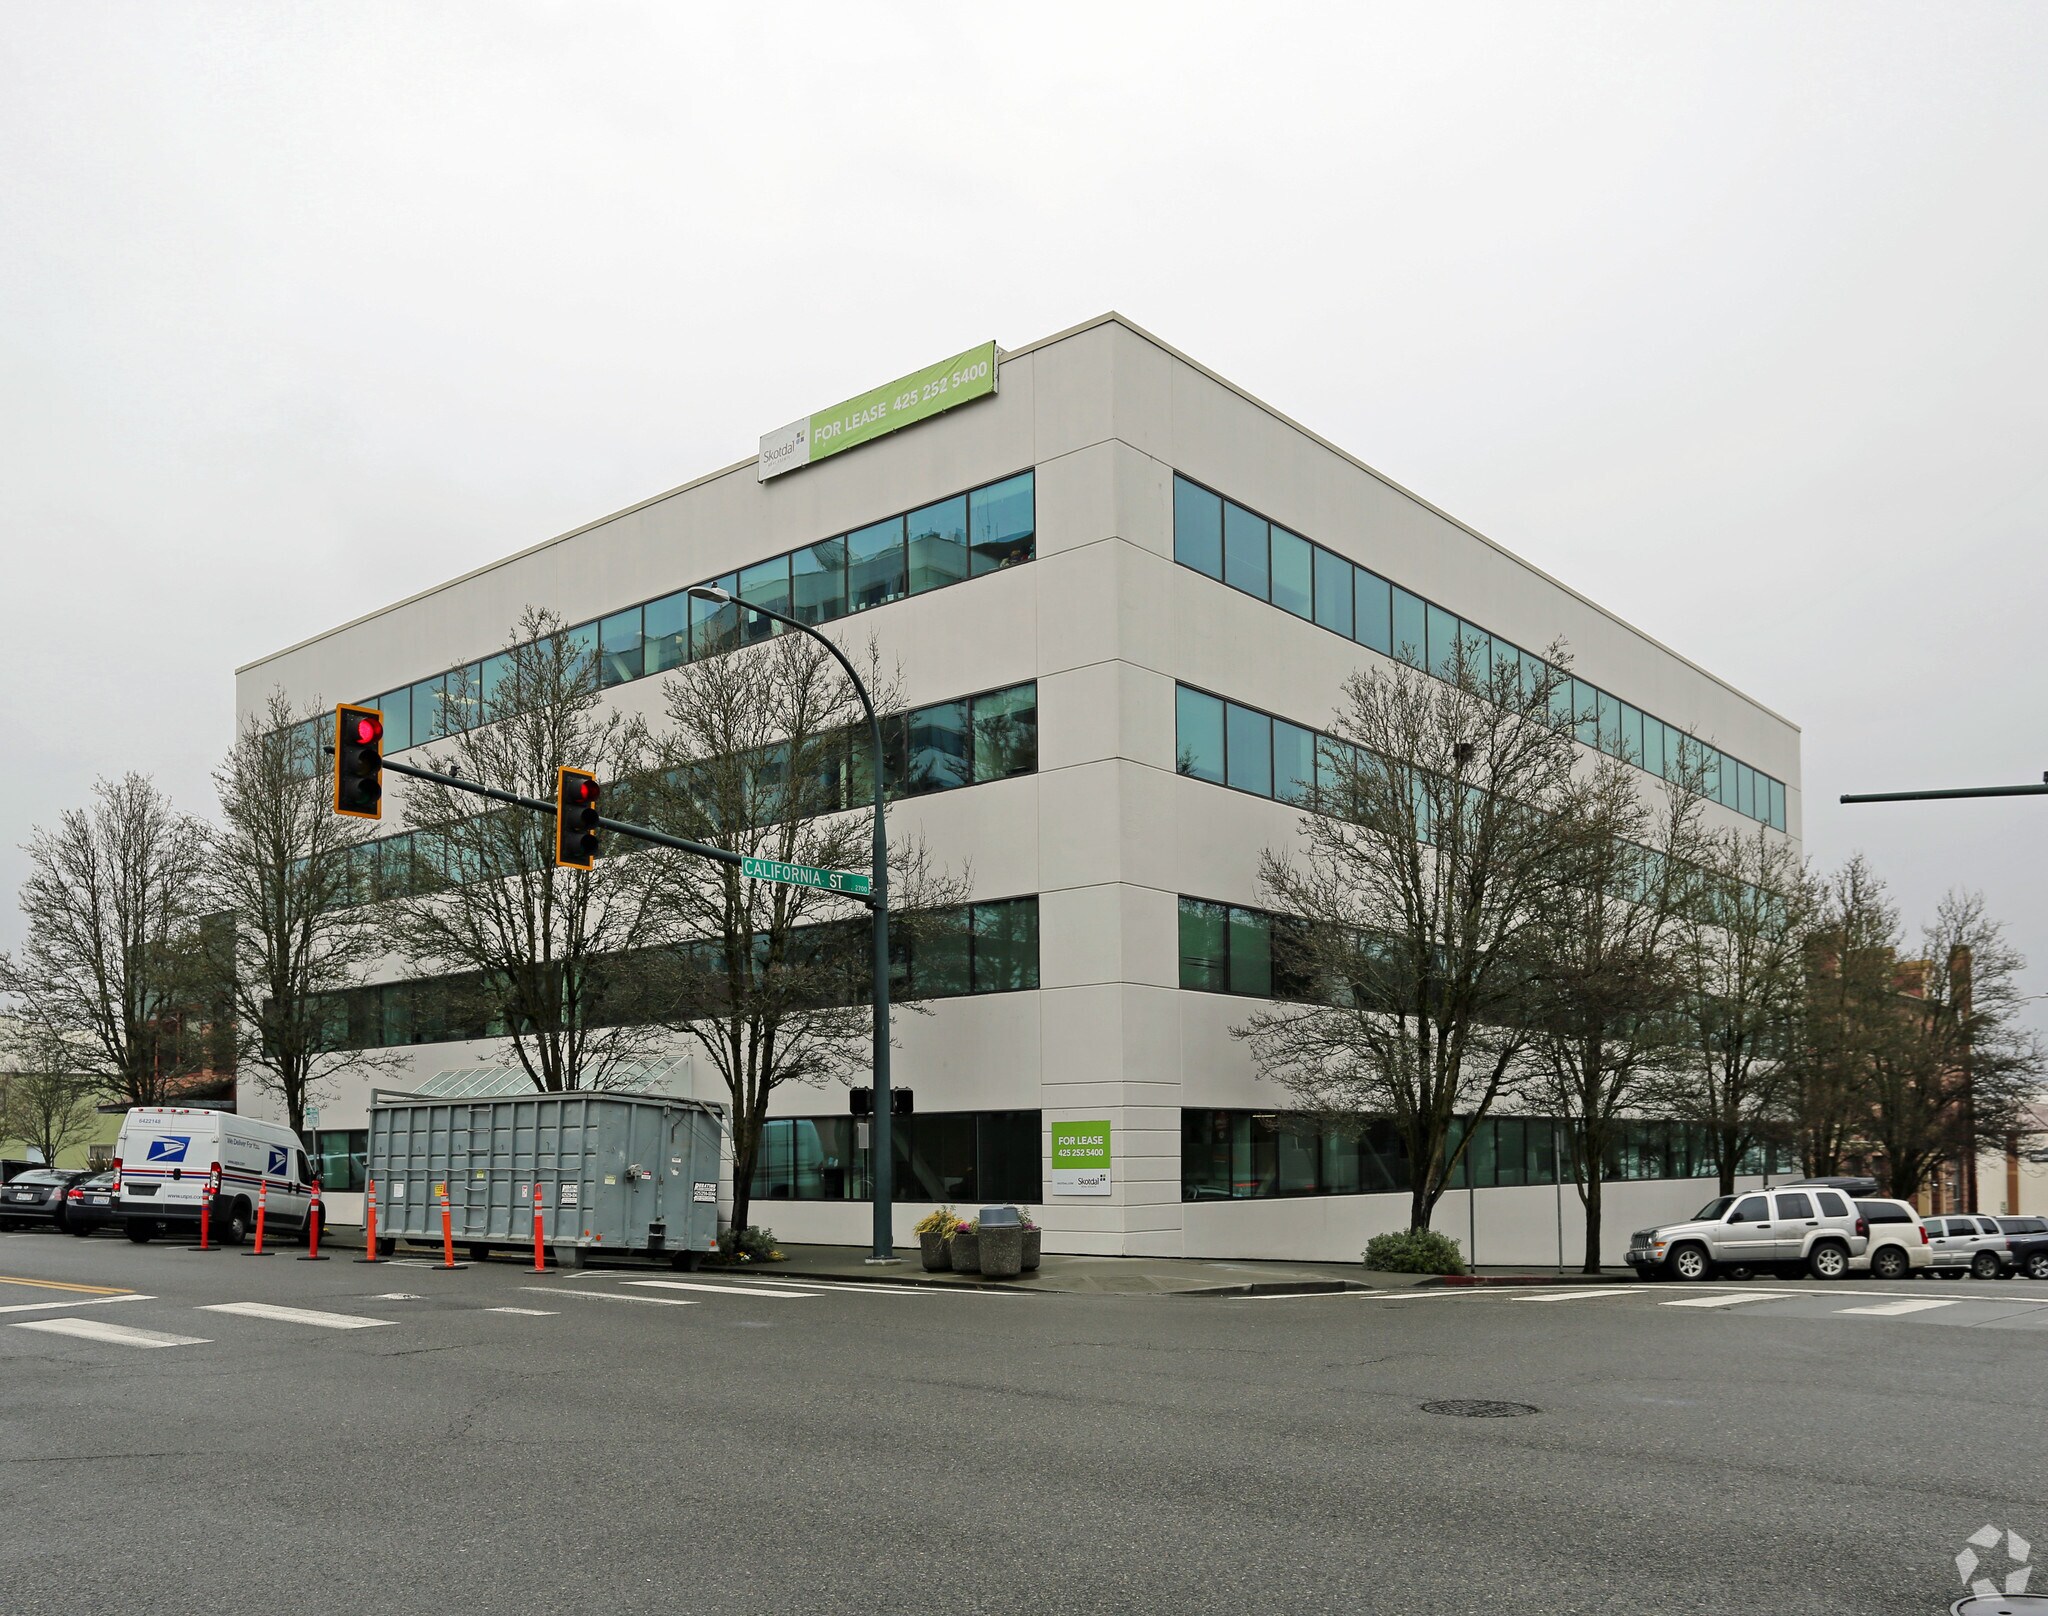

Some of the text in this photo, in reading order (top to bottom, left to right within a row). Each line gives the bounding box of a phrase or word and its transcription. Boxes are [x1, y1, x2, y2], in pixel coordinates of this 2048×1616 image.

[814, 361, 988, 444] FOR LEASE 425 252 5400
[763, 440, 795, 463] Skotdal
[744, 860, 843, 888] CALIFORNIA ST
[1058, 1136, 1103, 1145] FOR LEASE
